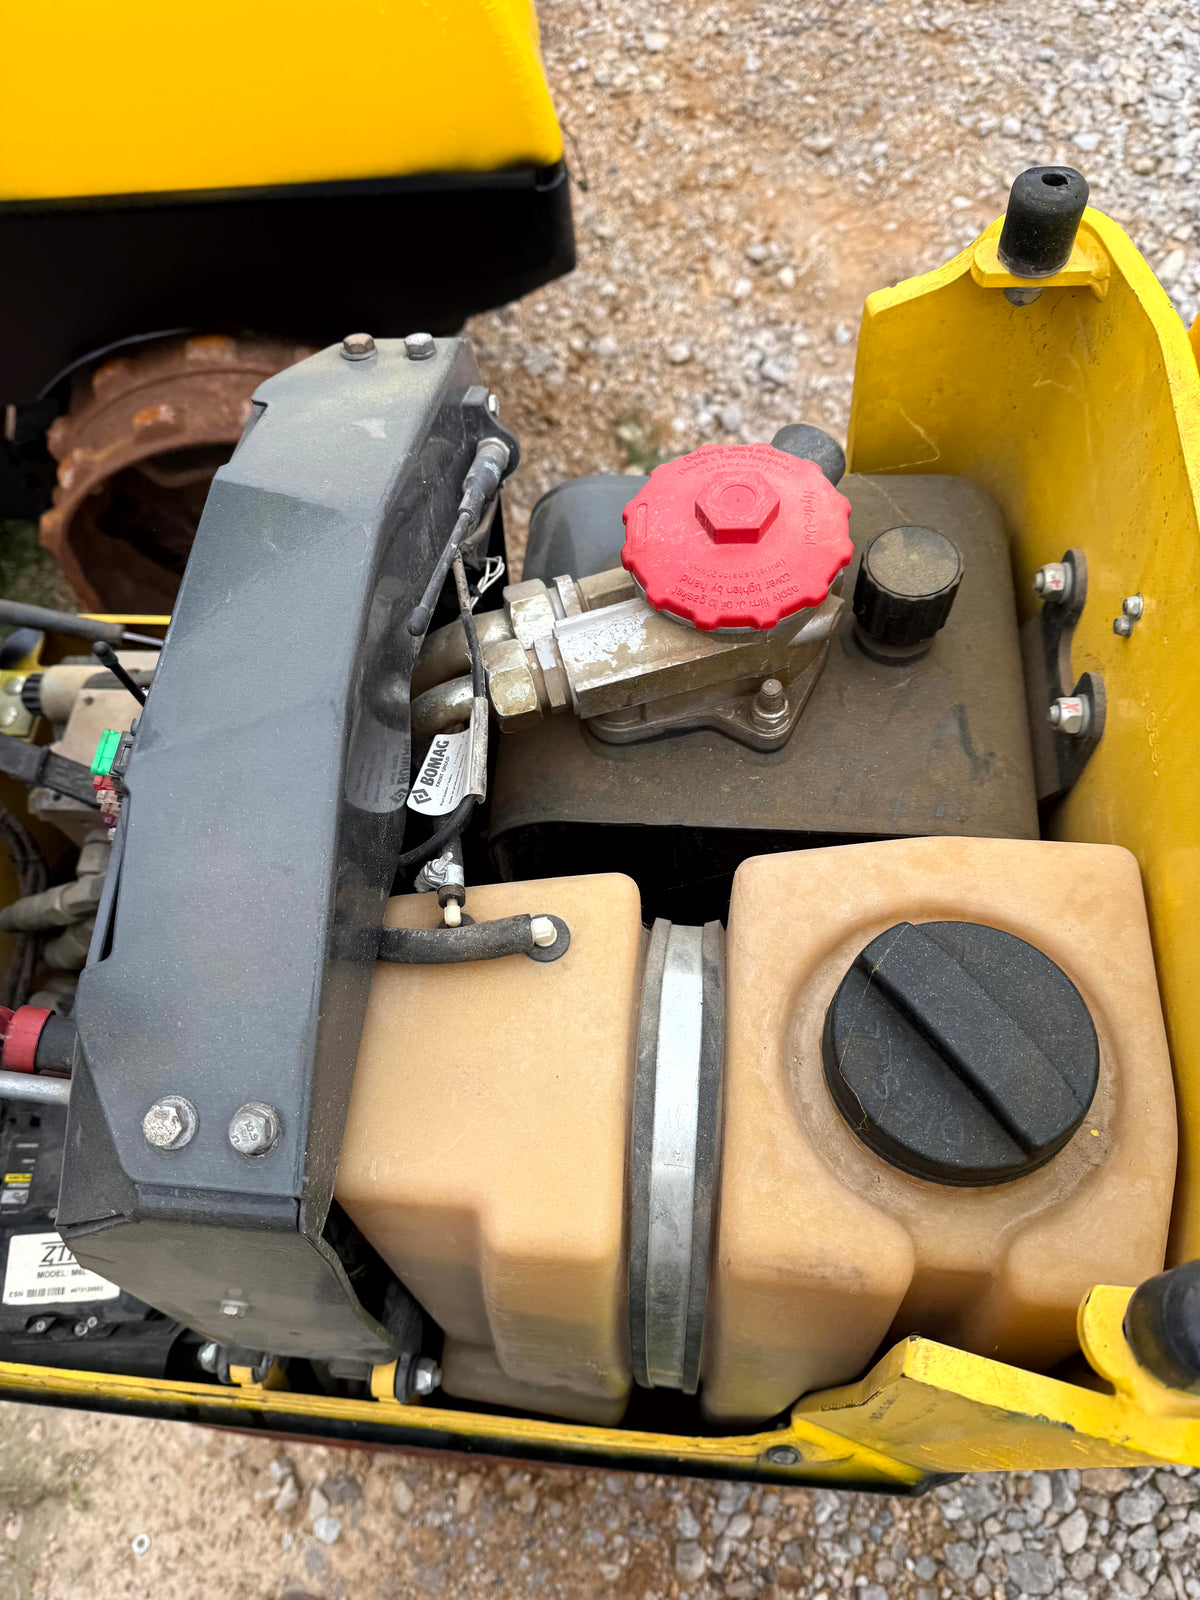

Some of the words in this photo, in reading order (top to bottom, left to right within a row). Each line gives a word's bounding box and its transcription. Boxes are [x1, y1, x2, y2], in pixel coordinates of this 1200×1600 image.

[679, 574, 707, 593] hand
[711, 583, 723, 595] by
[765, 573, 791, 589] cover
[671, 586, 707, 605] gasket
[727, 583, 762, 596] tighten
[773, 585, 800, 602] apply
[708, 599, 719, 610] to
[420, 740, 450, 787] BOMAG
[41, 1245, 75, 1265] ZT
[37, 1269, 69, 1279] MODEL:
